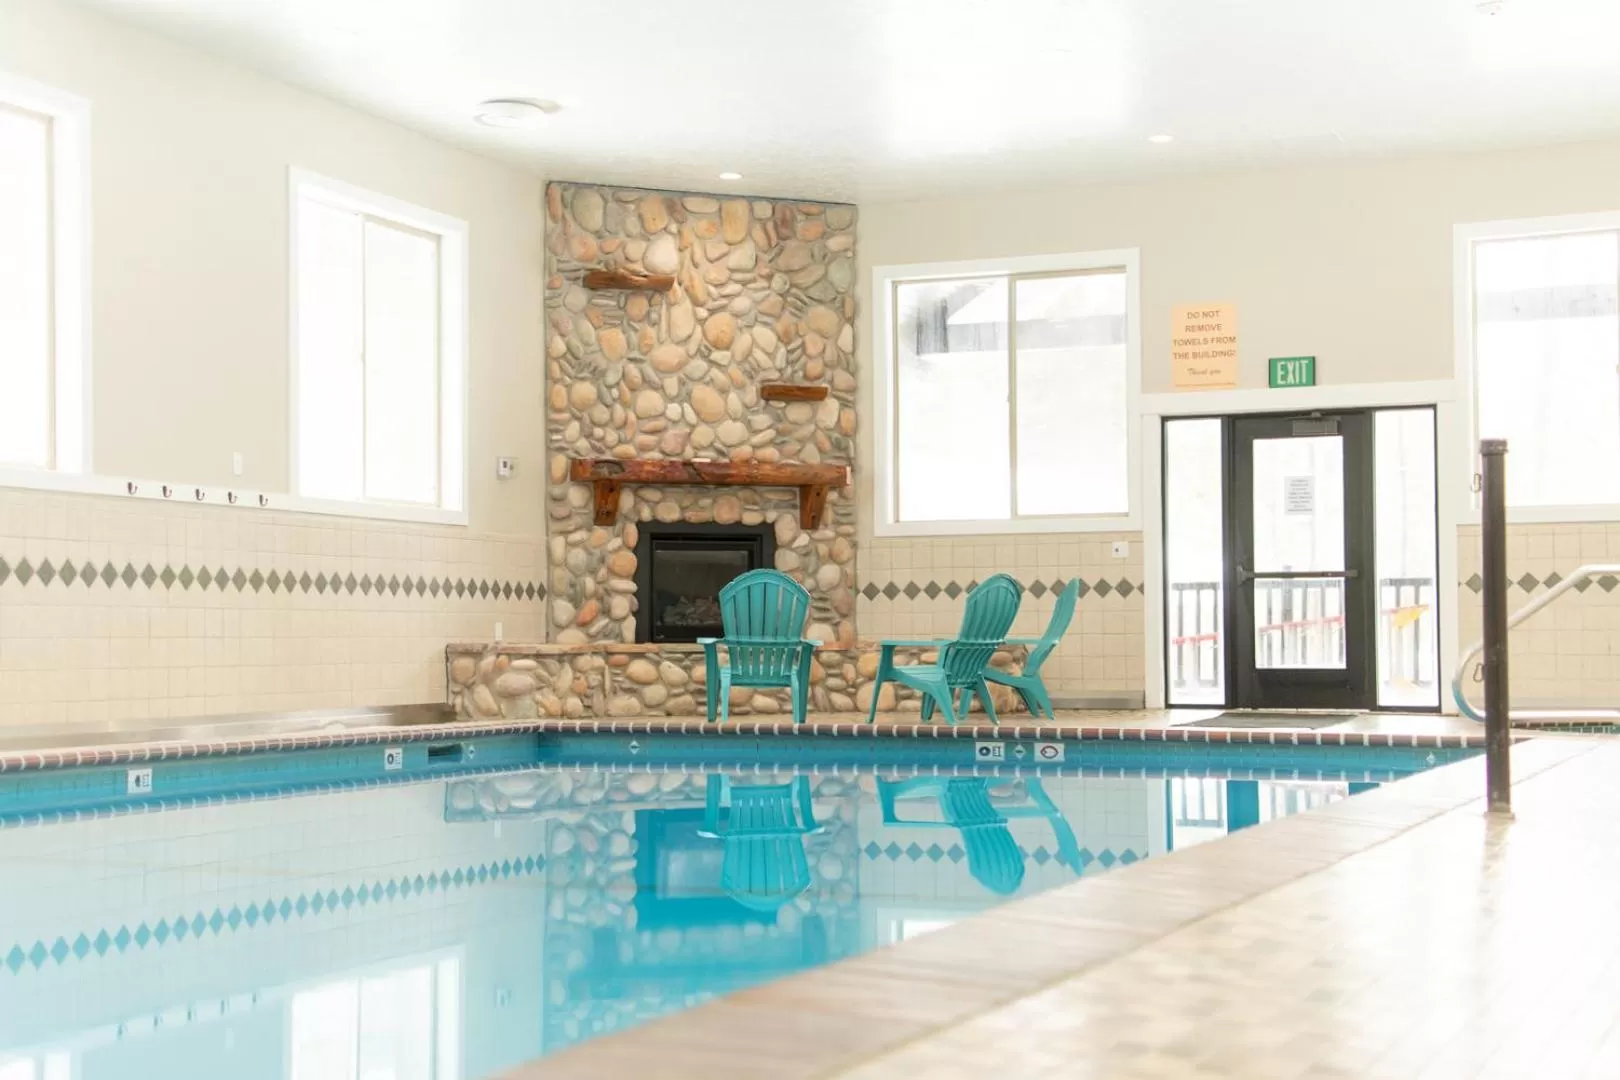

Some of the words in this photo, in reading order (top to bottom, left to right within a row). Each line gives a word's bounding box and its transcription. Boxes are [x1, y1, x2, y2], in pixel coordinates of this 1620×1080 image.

[1186, 311, 1200, 319] DO
[1202, 310, 1220, 319] NOT
[1184, 323, 1223, 332] REMOVE
[1173, 338, 1208, 347] TOWELS
[1210, 336, 1236, 345] FROM
[1173, 352, 1189, 360] THE
[1277, 360, 1309, 385] EXIT
